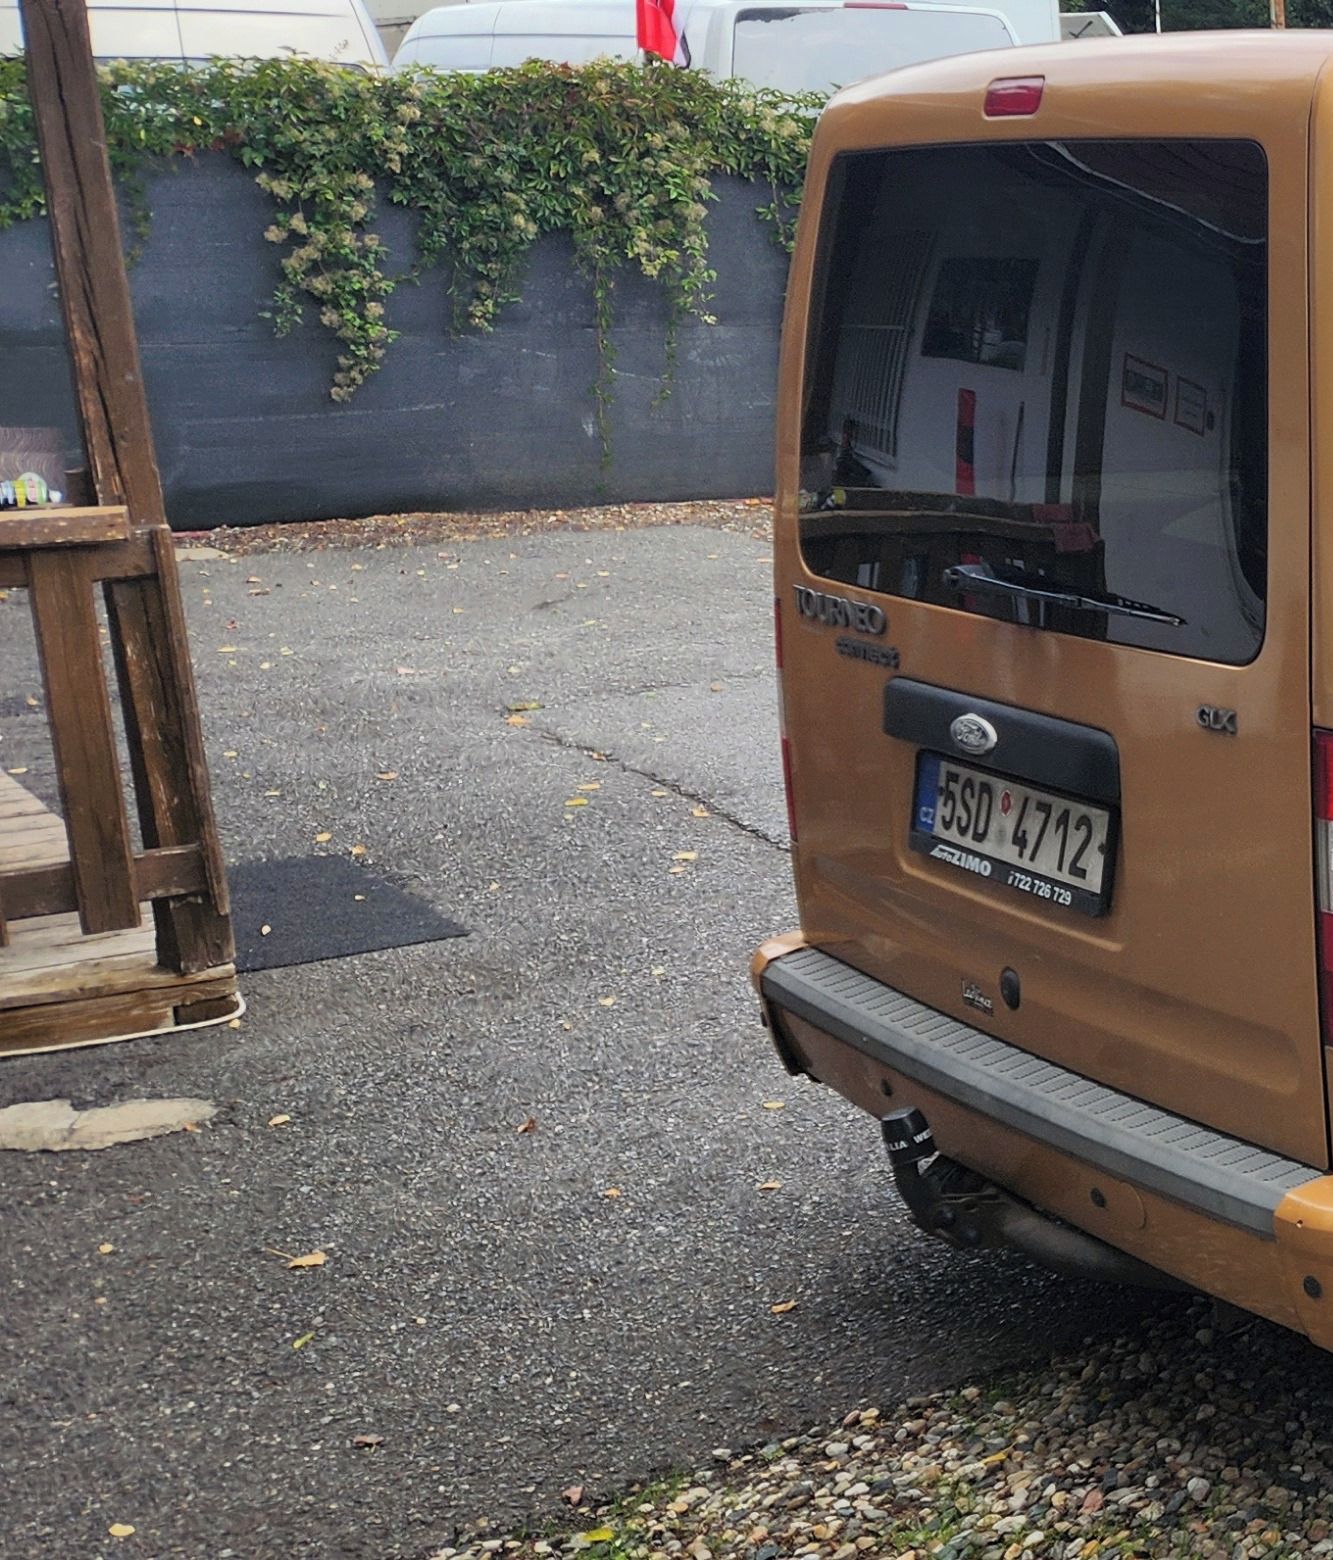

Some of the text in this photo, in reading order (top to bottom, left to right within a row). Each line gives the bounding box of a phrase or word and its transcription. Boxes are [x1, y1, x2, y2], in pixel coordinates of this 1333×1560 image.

[793, 585, 887, 635] TOURNEO
[1195, 705, 1237, 733] GLX
[919, 807, 934, 824] CZ
[941, 770, 1092, 880] 5SD 4712
[1033, 880, 1051, 898] 726
[1053, 887, 1072, 906] 729
